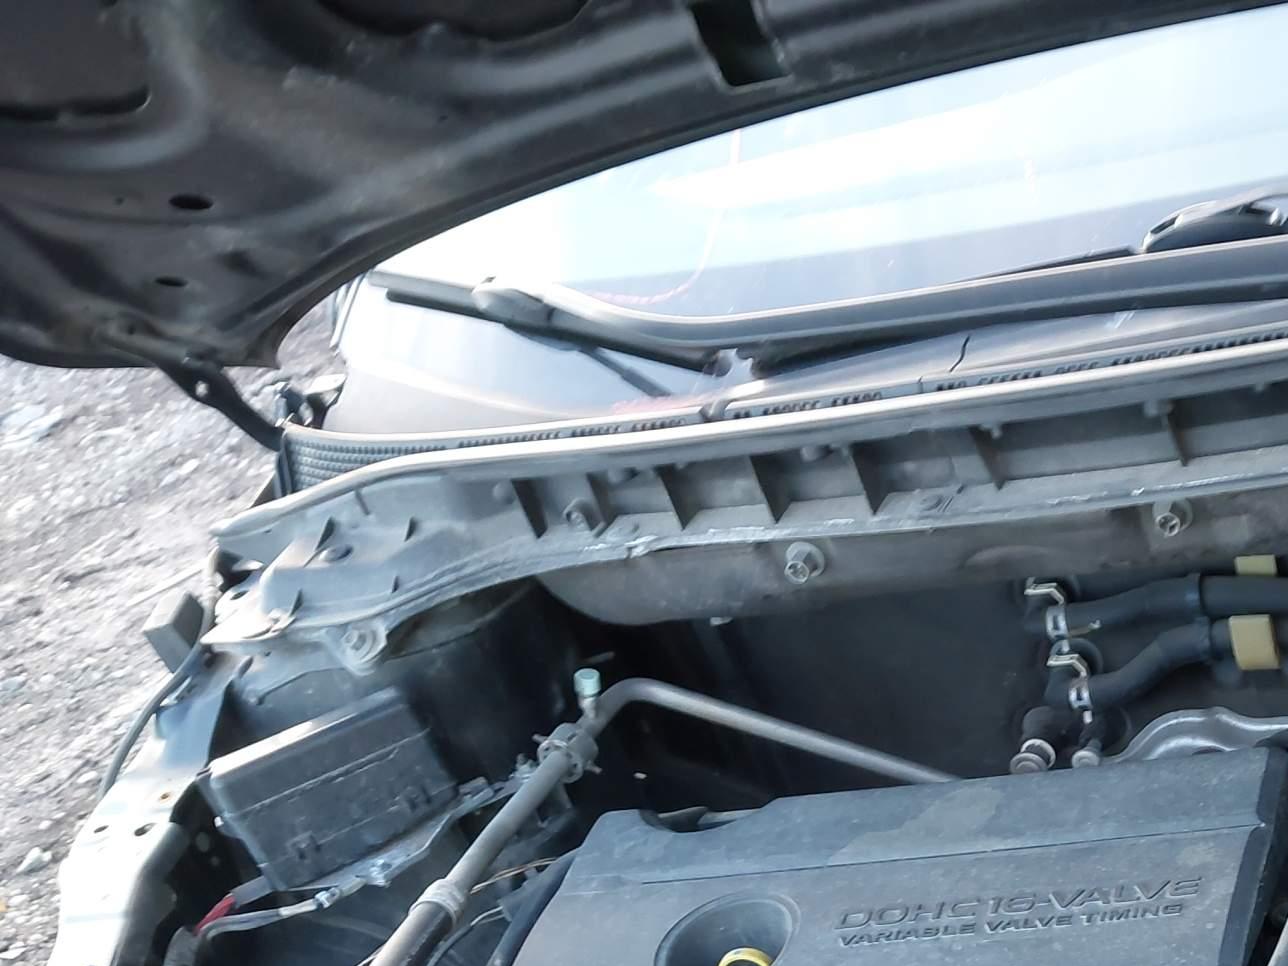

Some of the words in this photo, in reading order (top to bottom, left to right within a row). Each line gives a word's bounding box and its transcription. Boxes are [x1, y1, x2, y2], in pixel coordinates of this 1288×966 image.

[835, 898, 980, 930] DOHC
[988, 876, 1202, 916] 16-VALVE
[840, 922, 976, 946] VARIABLE
[985, 915, 1072, 933] VALVE
[1080, 903, 1184, 926] TIMING
